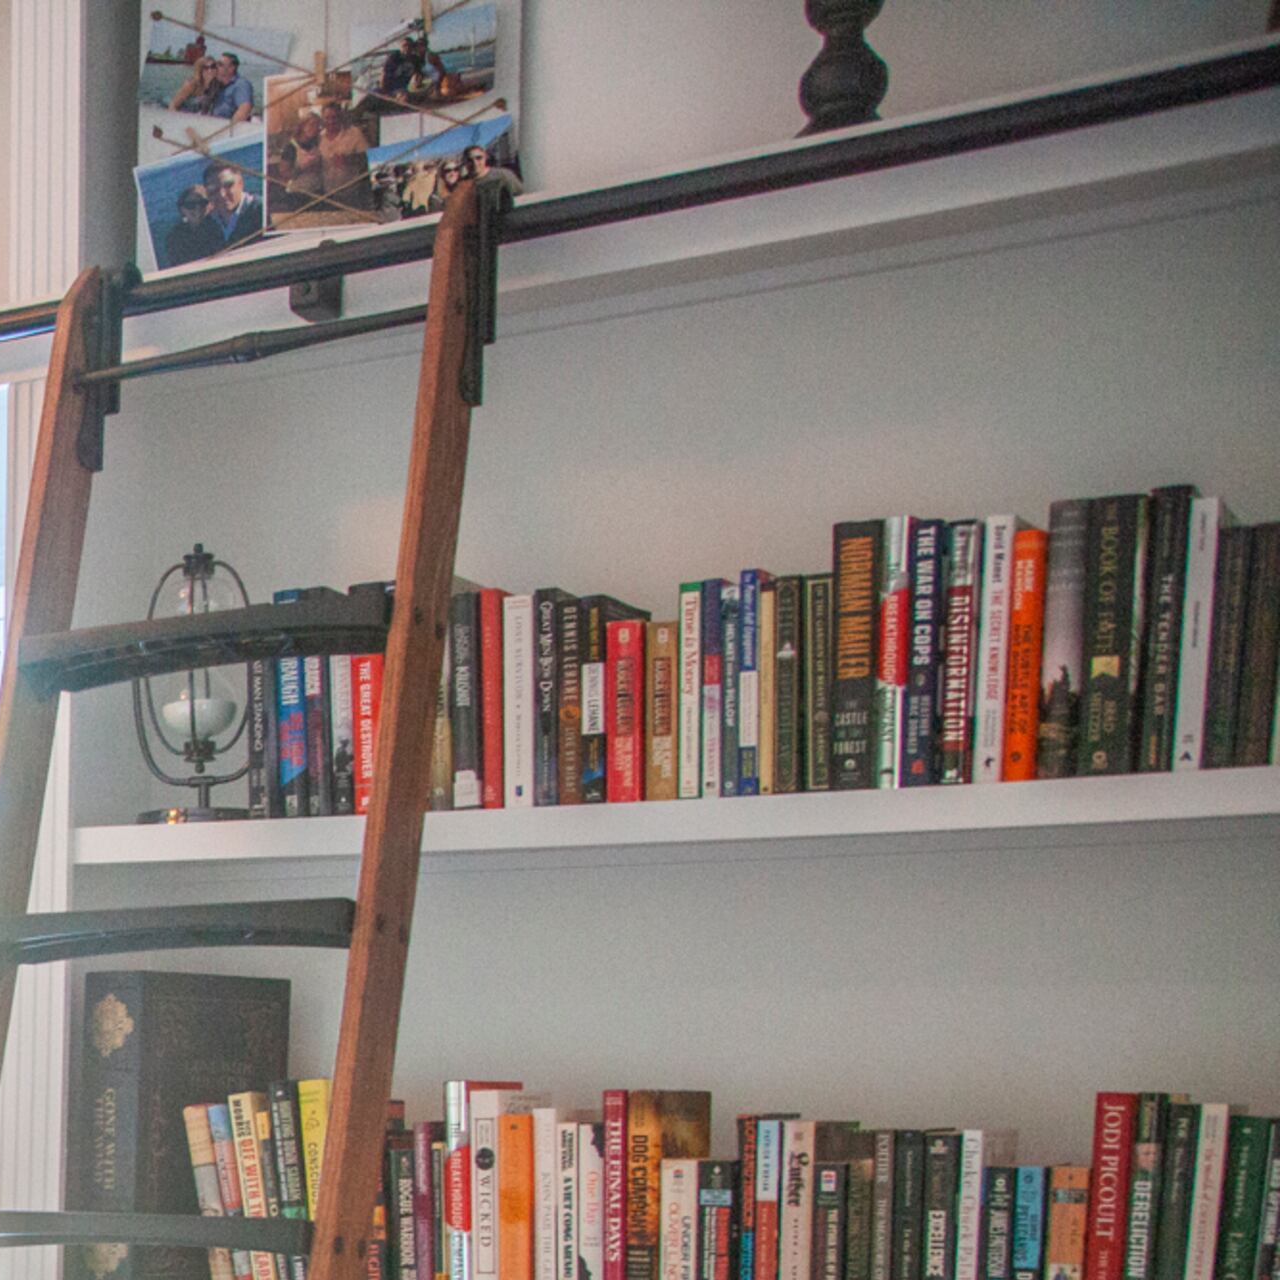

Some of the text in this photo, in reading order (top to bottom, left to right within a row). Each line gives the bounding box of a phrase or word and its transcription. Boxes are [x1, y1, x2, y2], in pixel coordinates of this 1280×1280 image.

[913, 526, 934, 667] THE WAR ON COPS
[1012, 559, 1025, 611] MANSON
[1023, 559, 1034, 592] MARK
[684, 596, 698, 630] Time
[837, 537, 873, 679] NORMAN MAILER
[985, 525, 1007, 701] David Mamet THE SECRET KNOWLEDGE
[540, 601, 552, 712] GREAT MEN BOW DOWN
[684, 634, 697, 647] is
[1153, 573, 1173, 716] THE TENDER BAR
[586, 665, 600, 697] DENNIS
[678, 650, 697, 696] Money
[943, 594, 970, 742] DISINFORMATION
[359, 661, 374, 780] THE GREAT DESTROYER
[563, 606, 578, 793] DENNIS LEHANE LIVE BY NIGHT
[586, 699, 600, 731] LEHANE
[834, 712, 867, 726] CASTLE
[1088, 693, 1102, 742] MELTZER
[1103, 700, 1115, 734] BRAD
[833, 740, 867, 755] FOREST
[102, 1087, 116, 1191] GONE WITH
[231, 1099, 246, 1138] MORRIS
[93, 1137, 104, 1185] WIND
[241, 1138, 255, 1161] OFF
[964, 1137, 981, 1187] Choke
[1095, 1102, 1126, 1242] JODI PICOULT
[244, 1163, 260, 1199] WITH
[449, 1150, 464, 1232] BREAKTHROUGH
[584, 1170, 600, 1225] One Day
[606, 1119, 622, 1262] THE FINAL DAYS
[630, 1134, 648, 1240] DOG COMPANY
[398, 1178, 416, 1267] ROGUE WARRIOR
[480, 1175, 491, 1248] WICKED
[959, 1195, 977, 1239] Chuck
[1127, 1180, 1152, 1278] DERELICTION
[681, 1215, 691, 1261] UNDER
[1227, 1232, 1243, 1269] Little
